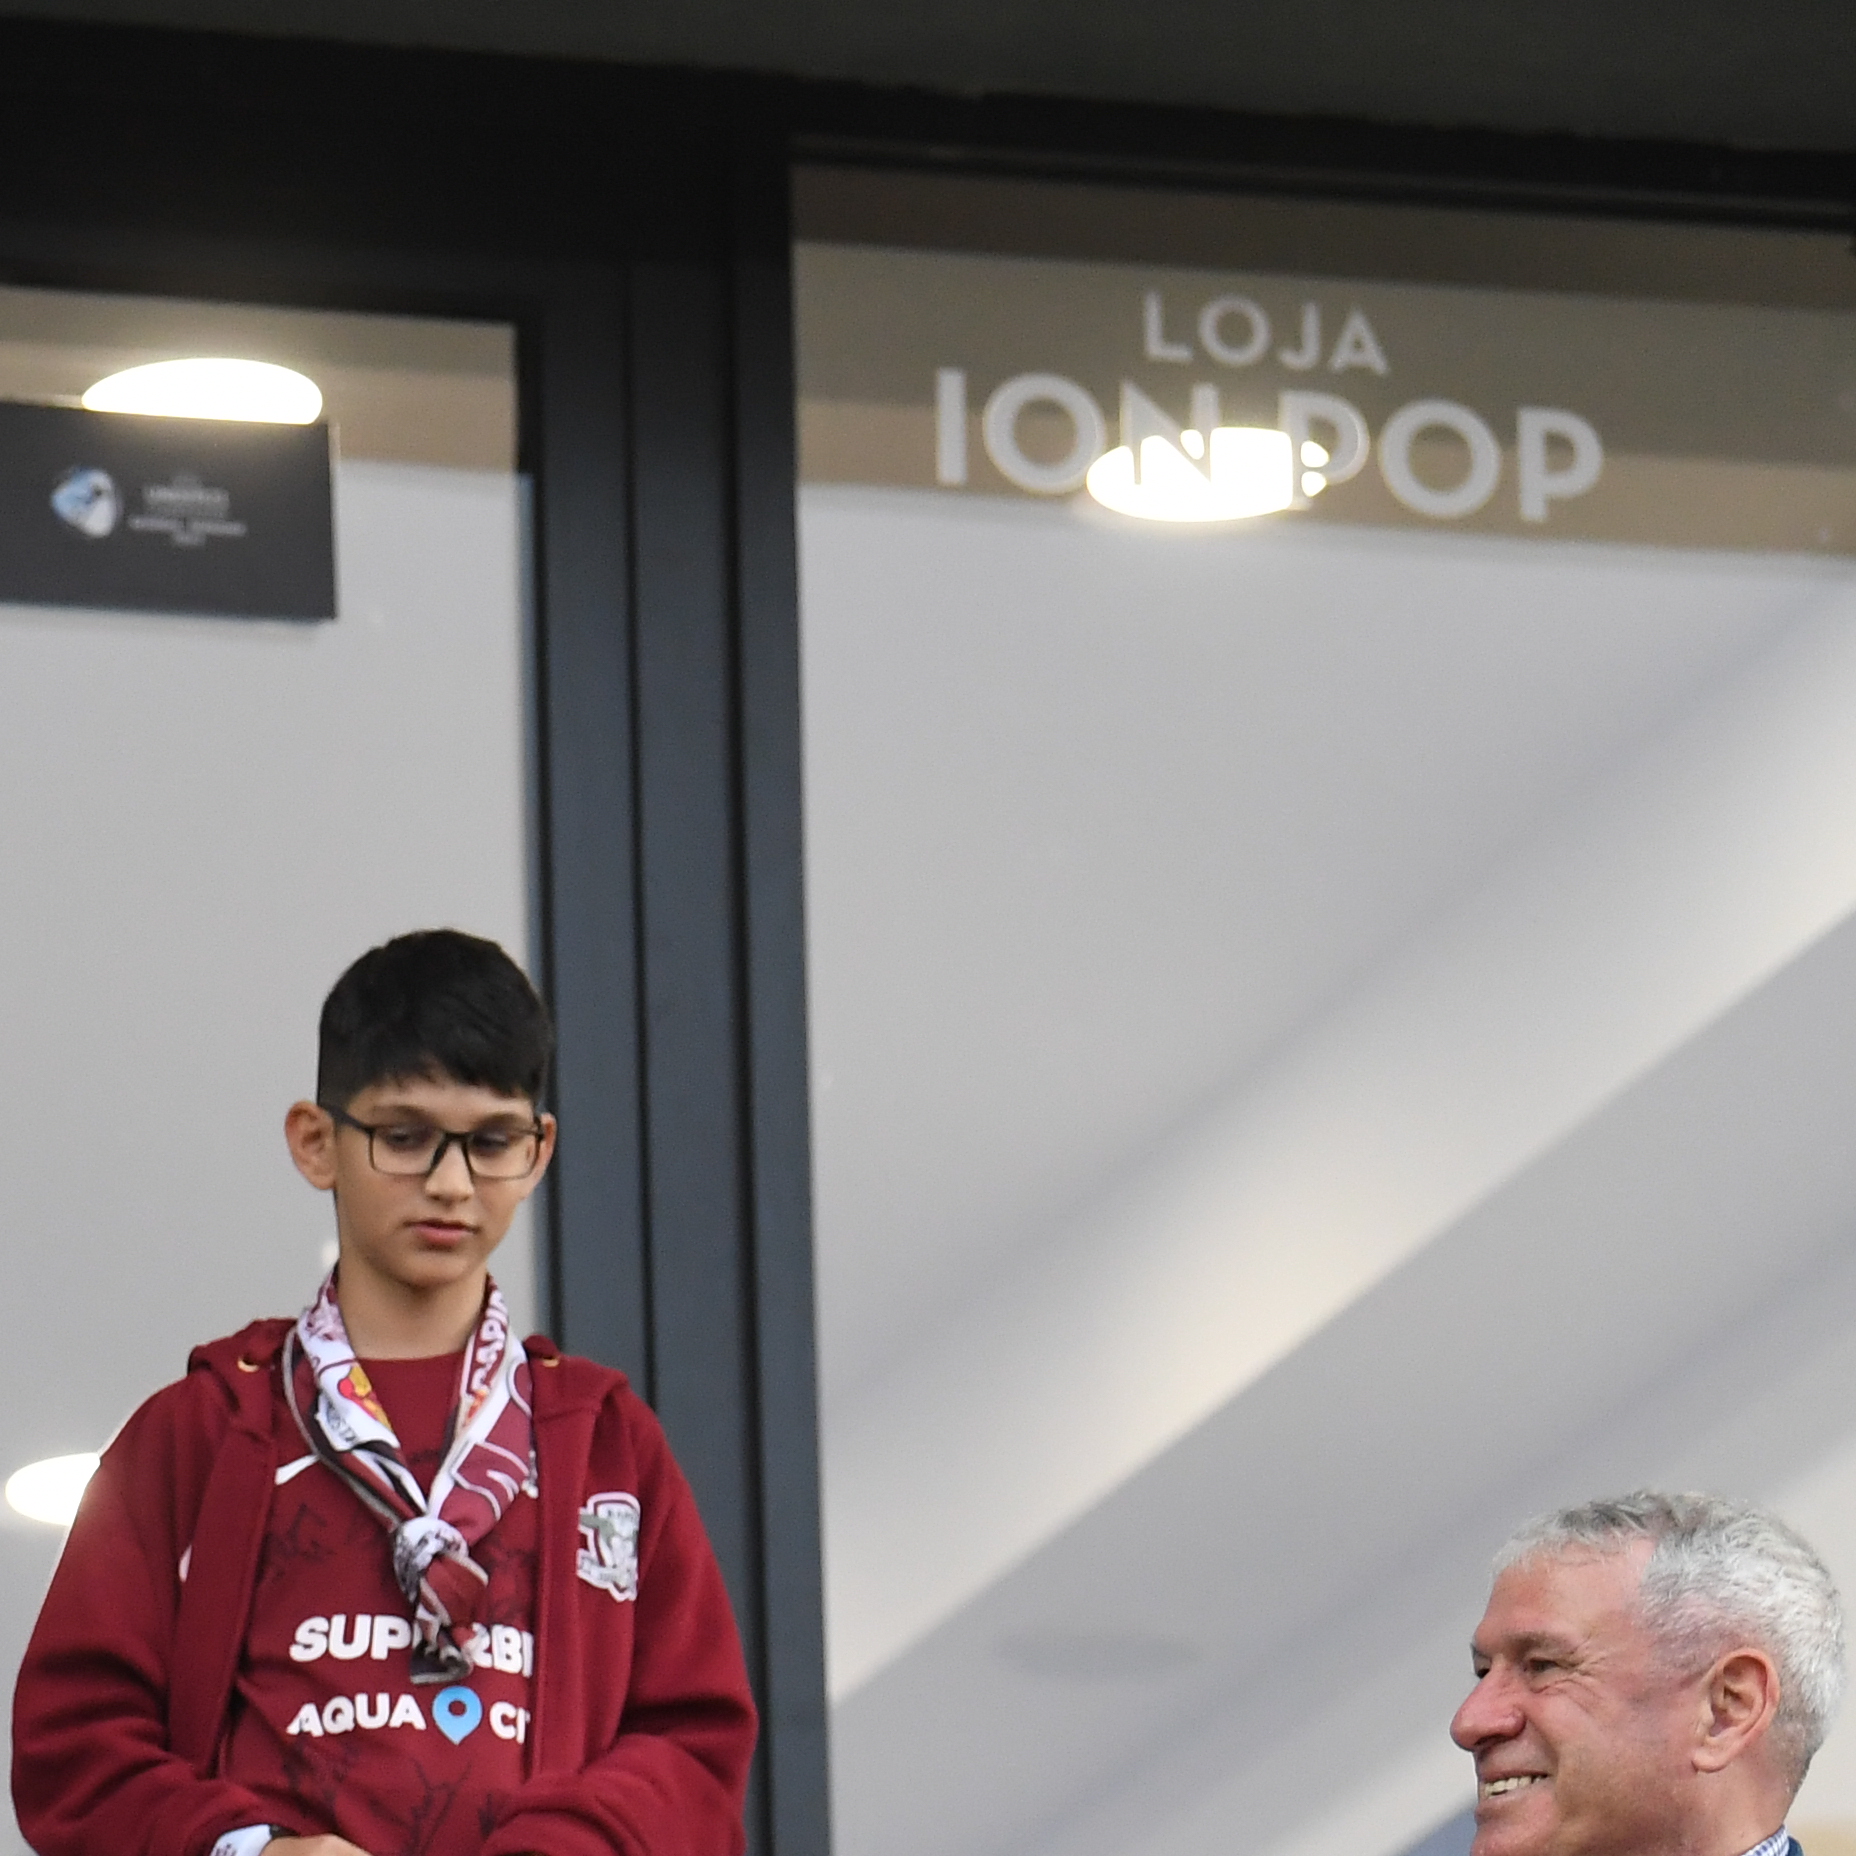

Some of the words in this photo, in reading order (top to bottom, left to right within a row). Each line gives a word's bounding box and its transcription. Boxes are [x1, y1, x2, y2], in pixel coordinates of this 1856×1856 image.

[1143, 290, 1390, 376] LOJA
[1277, 389, 1605, 523] POP
[286, 1692, 426, 1738] AQUA
